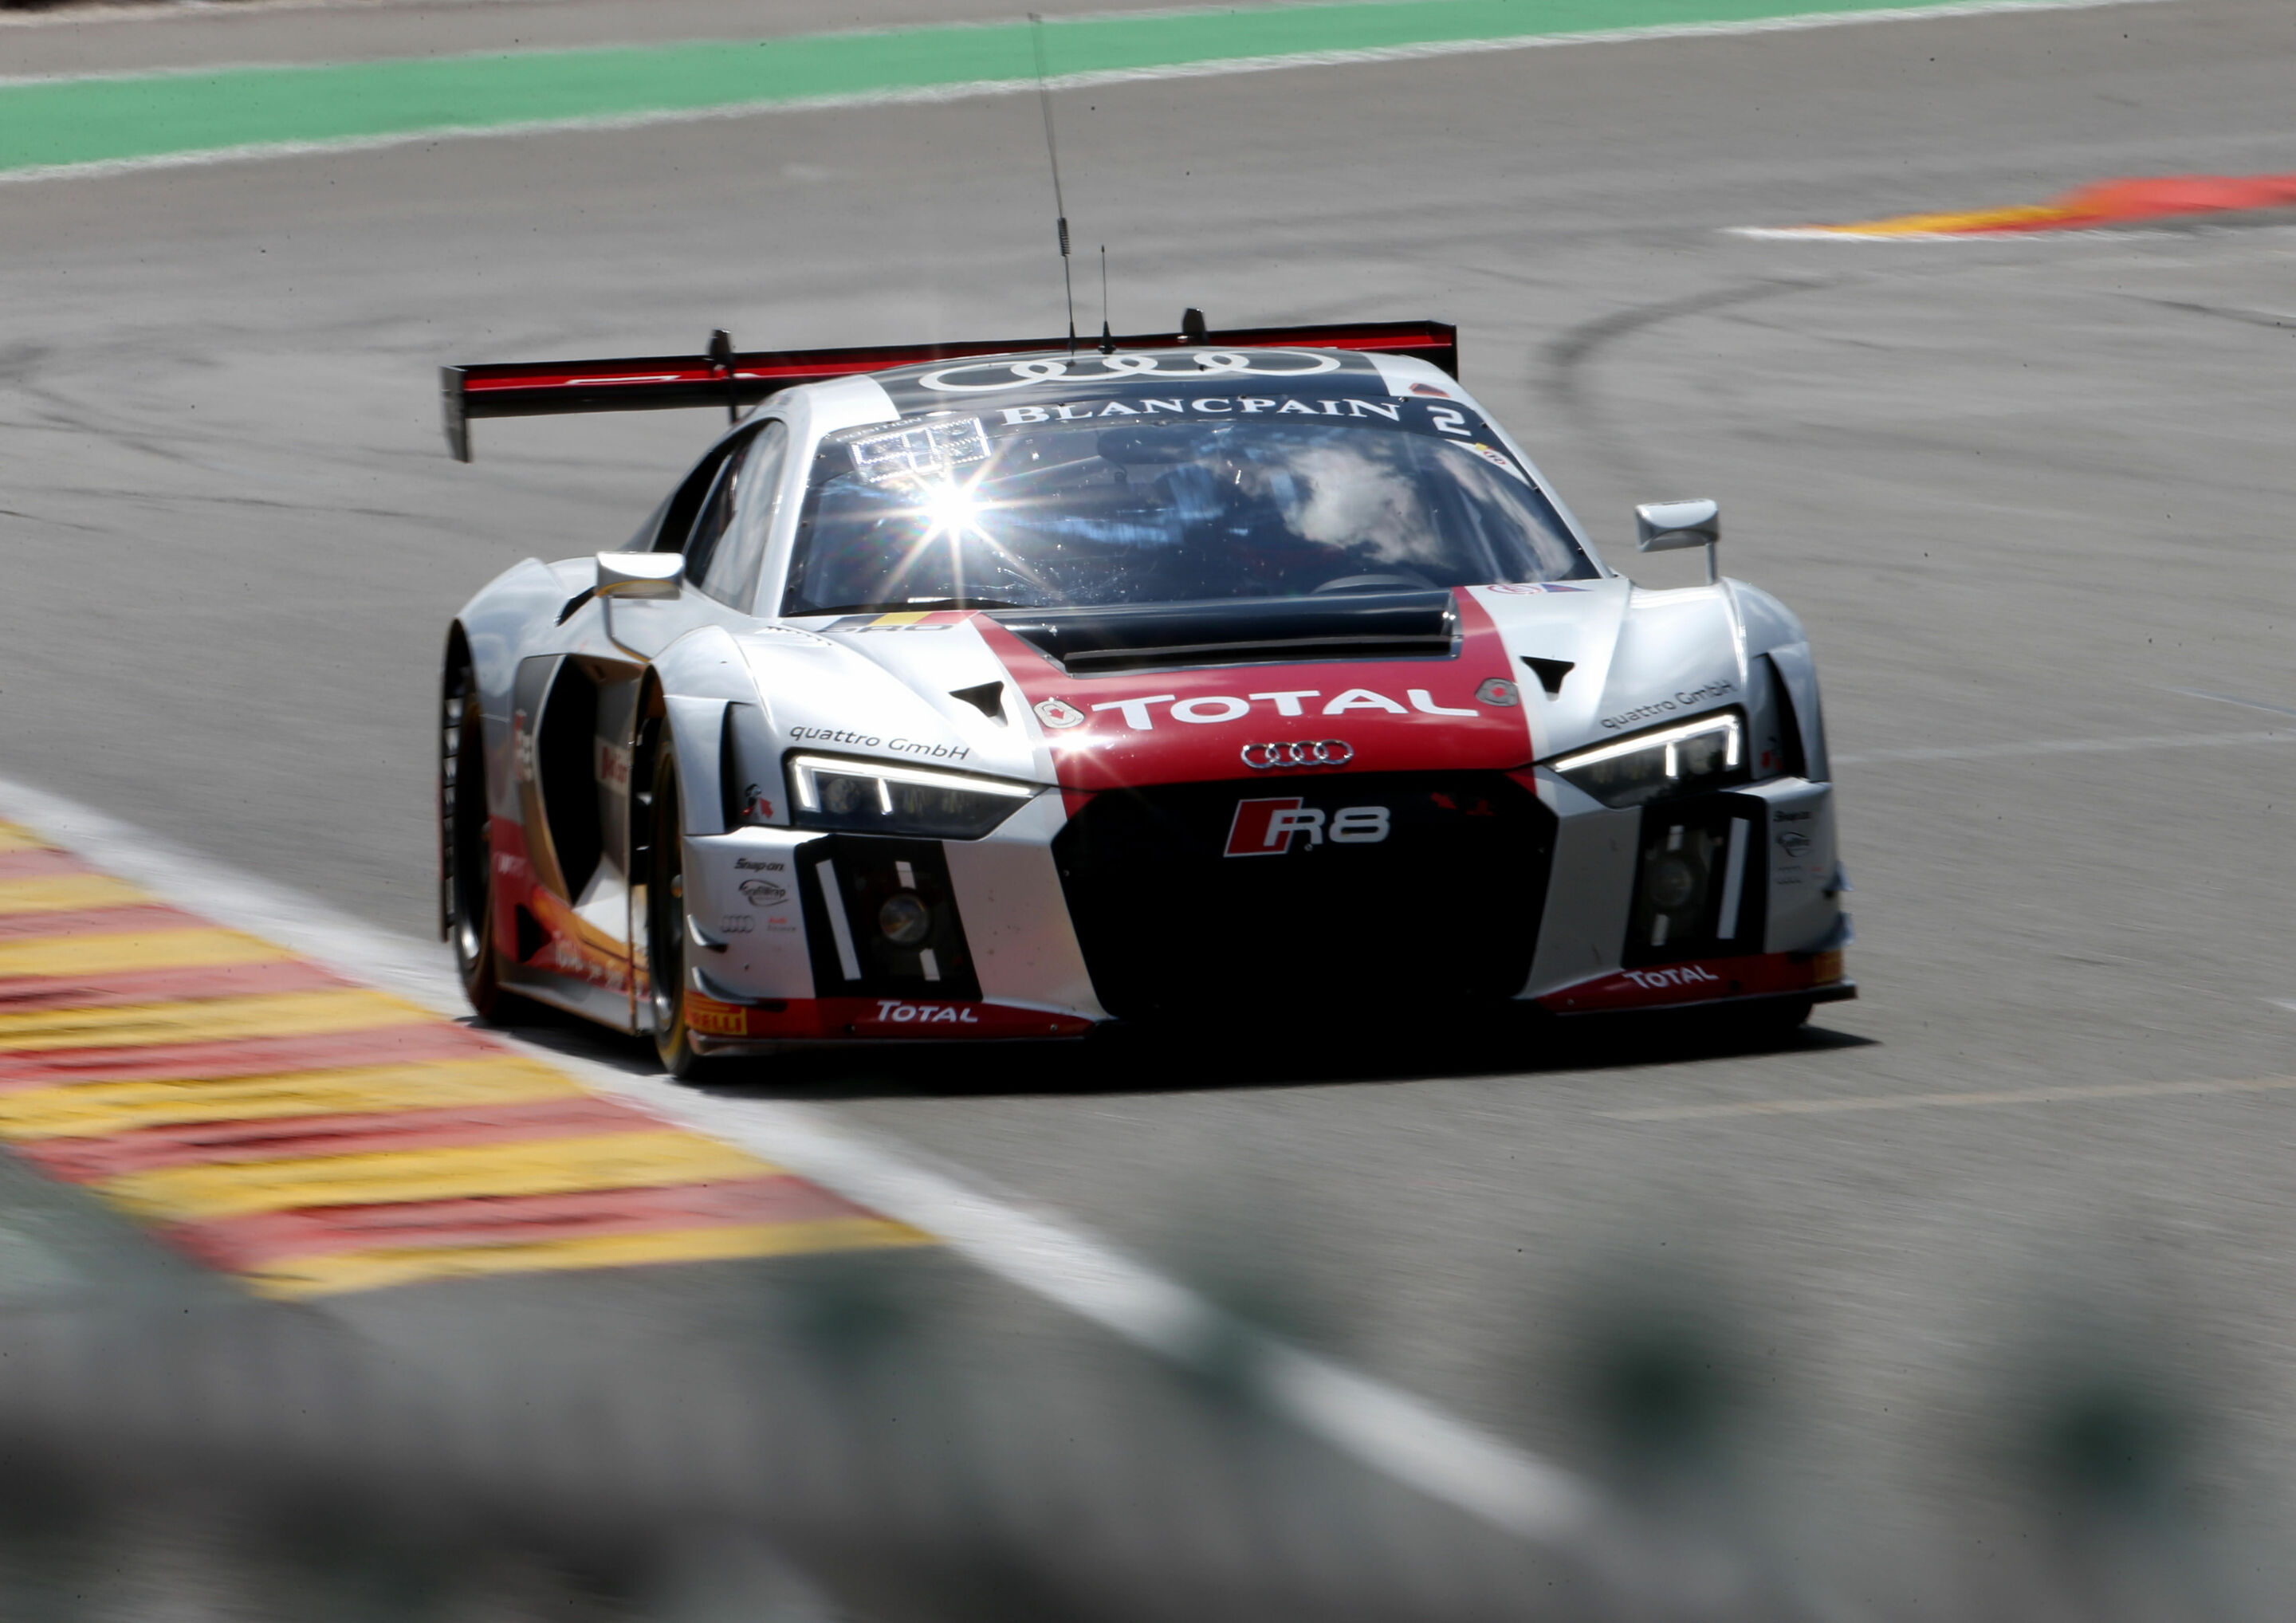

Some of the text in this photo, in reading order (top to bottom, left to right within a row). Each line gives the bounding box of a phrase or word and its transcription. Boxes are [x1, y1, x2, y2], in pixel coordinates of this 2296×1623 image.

[996, 398, 1401, 426] BLANCPAIN
[1427, 406, 1472, 436] 2
[1091, 688, 1480, 730] TOTAL
[1599, 679, 1739, 730] quattro GmbH
[788, 725, 970, 760] quattro GmbH
[1264, 805, 1390, 847] R8
[1622, 964, 1720, 989] TOTAL
[876, 1000, 979, 1023] TOTAL
